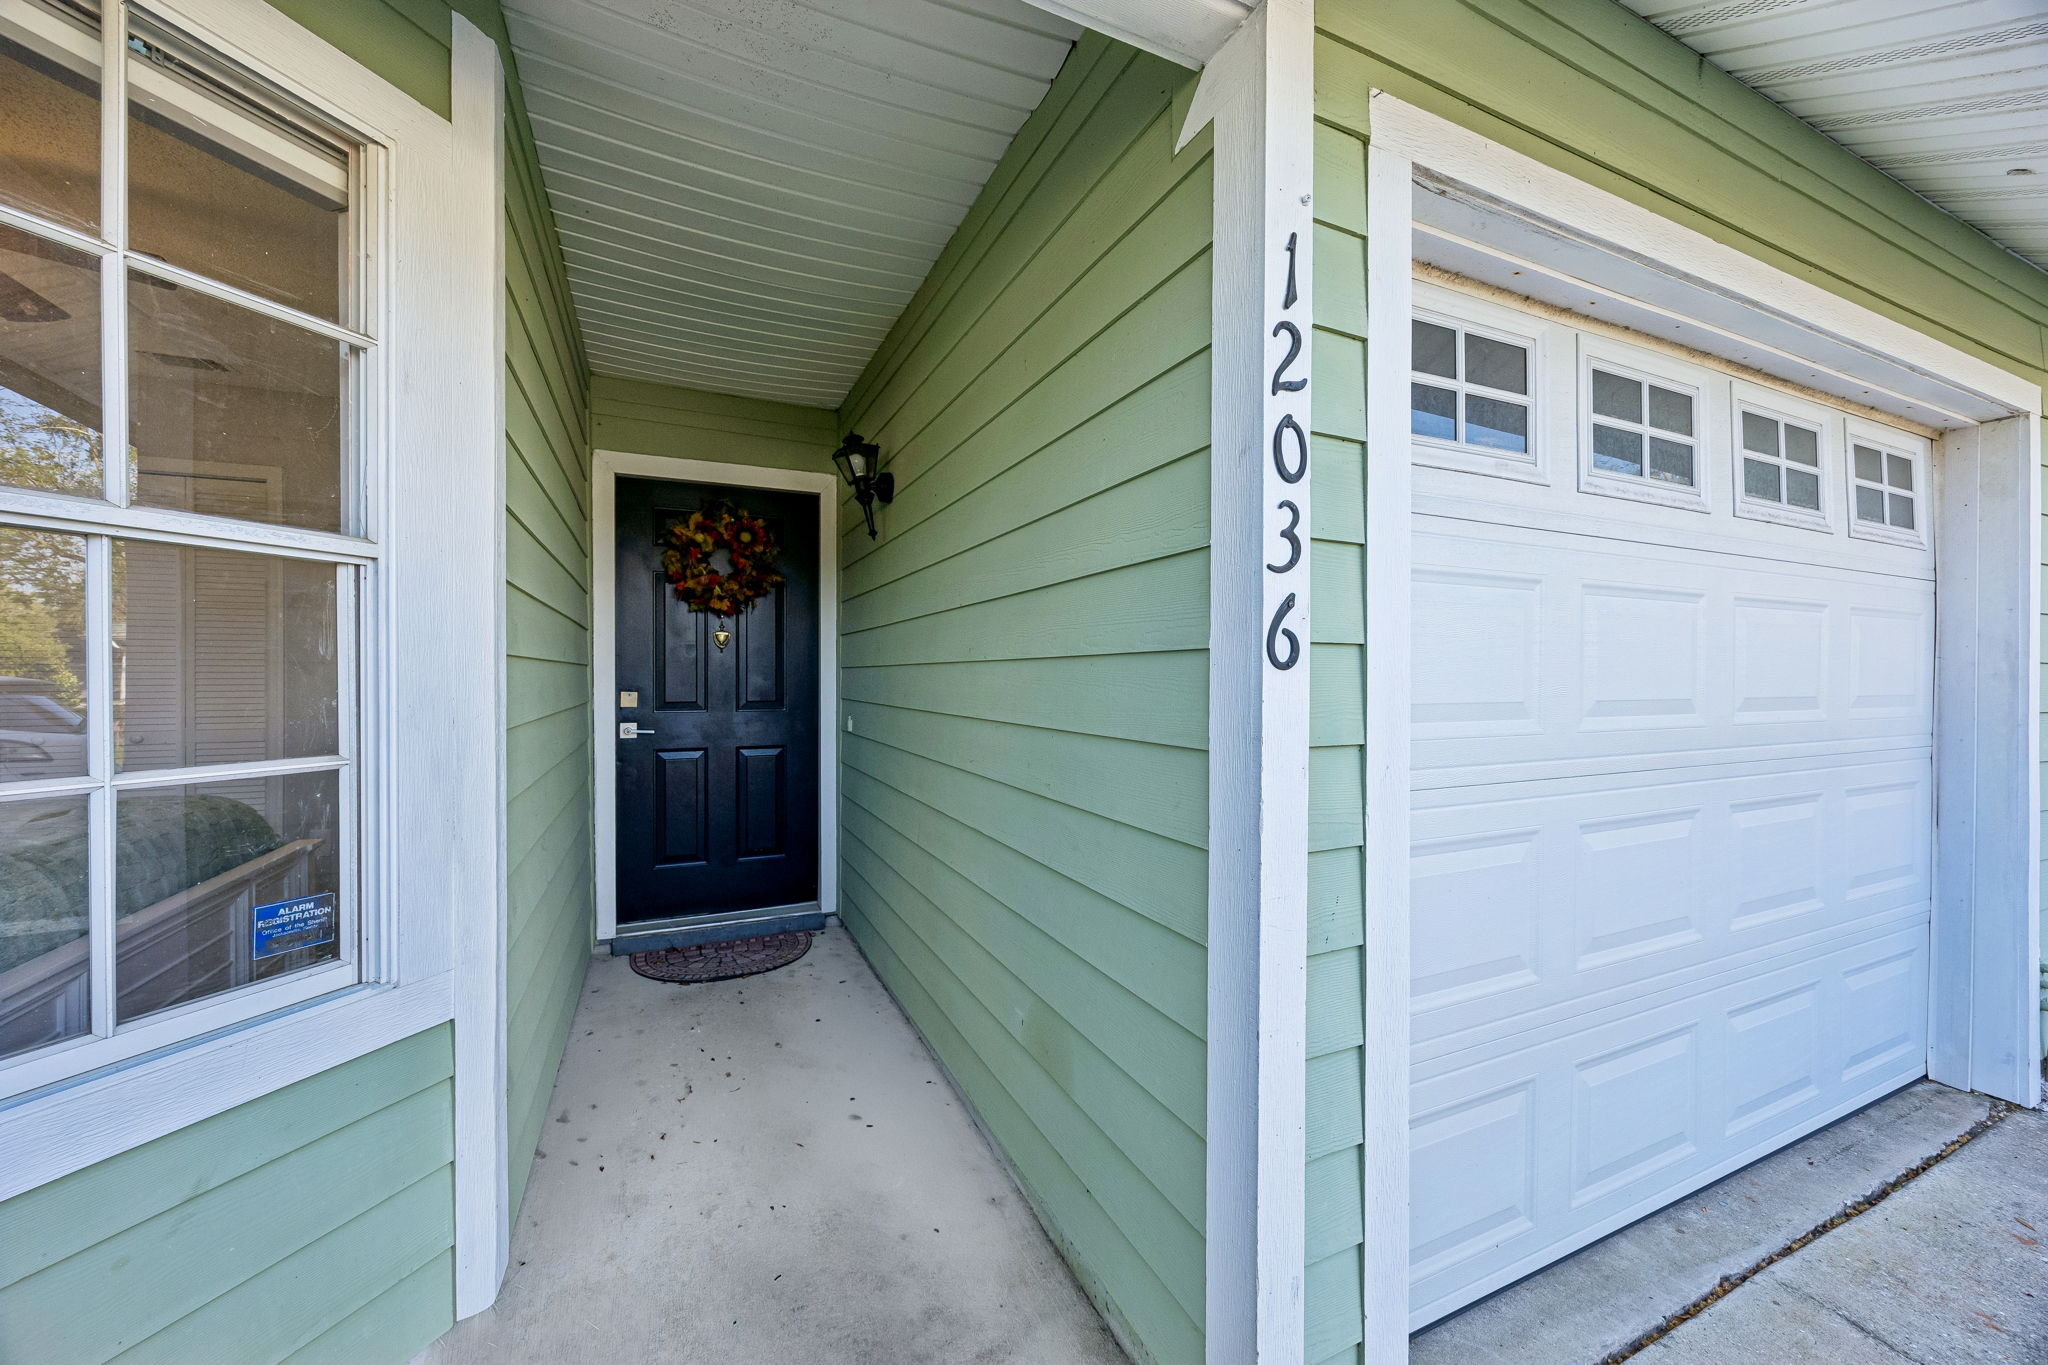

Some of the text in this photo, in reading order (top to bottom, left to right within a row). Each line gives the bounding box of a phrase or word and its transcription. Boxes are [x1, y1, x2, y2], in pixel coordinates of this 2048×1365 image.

[1266, 231, 1308, 671] 12036
[257, 906, 332, 928] REGISTRATION
[278, 902, 315, 916] ALARM
